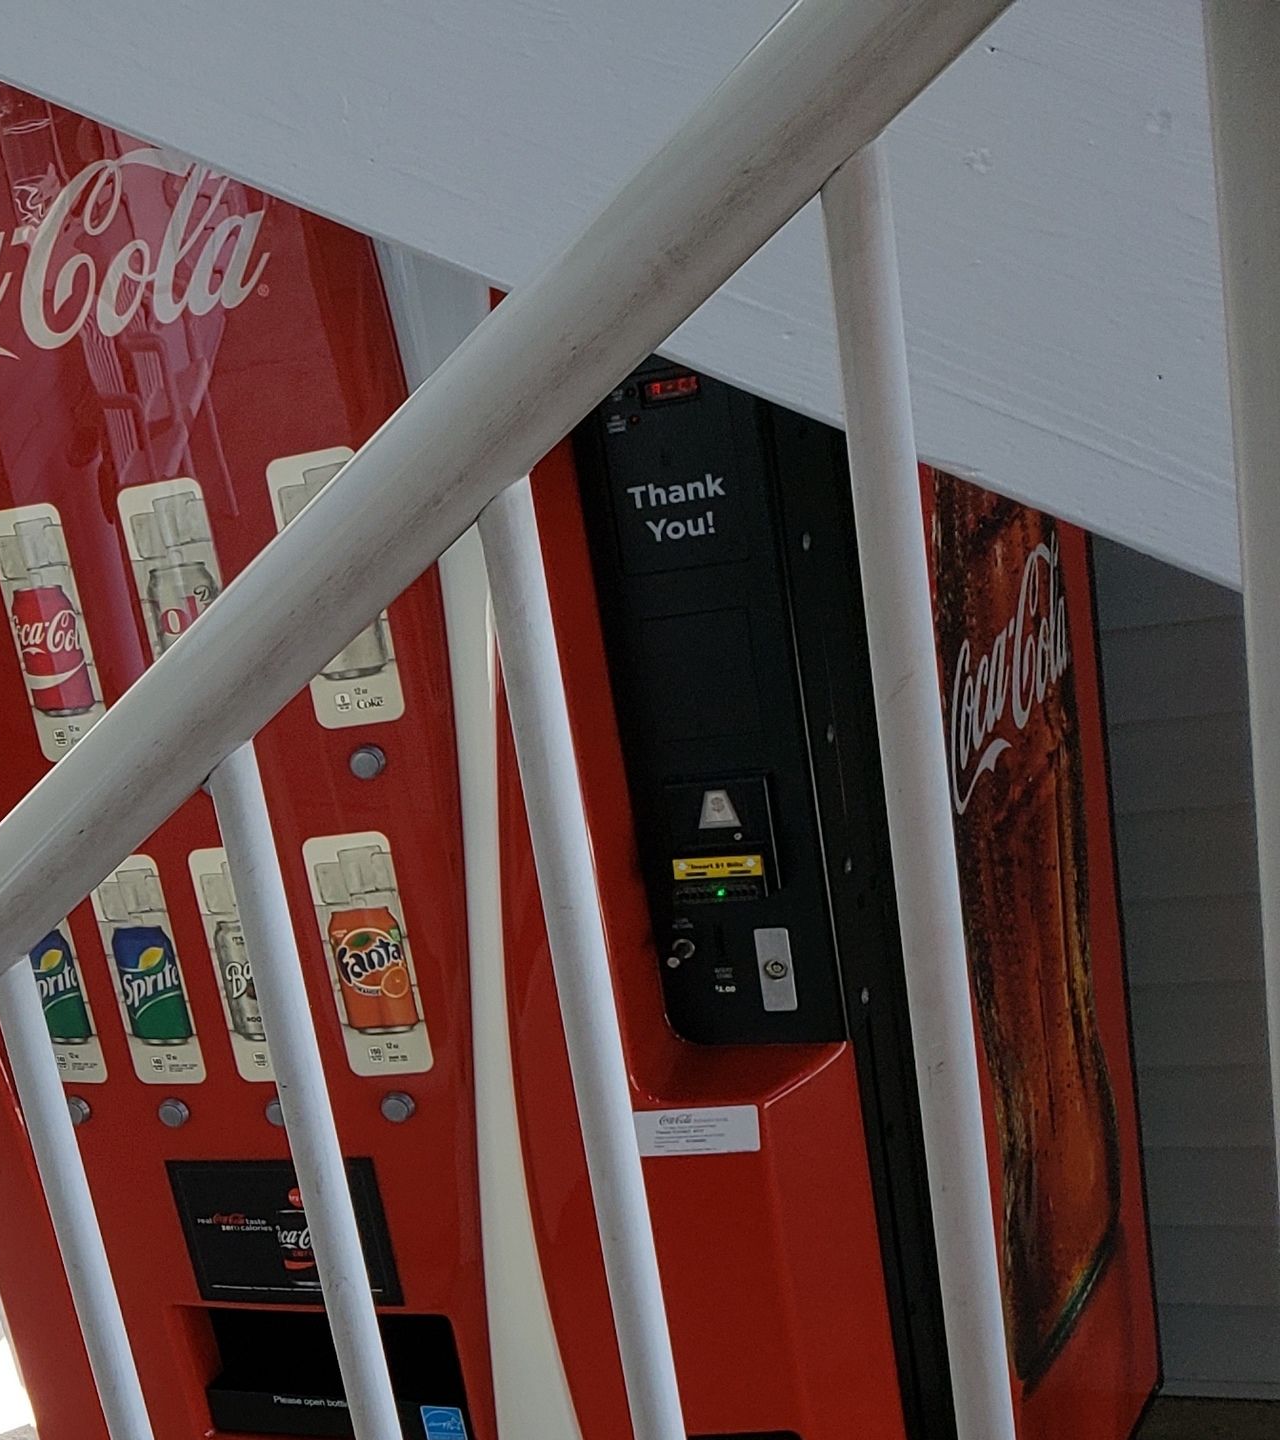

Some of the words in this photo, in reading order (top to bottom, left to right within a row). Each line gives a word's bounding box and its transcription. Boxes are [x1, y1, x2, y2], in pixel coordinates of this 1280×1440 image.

[627, 474, 726, 509] Thank
[645, 511, 715, 542] You!
[951, 531, 1068, 815] Coca-Cola
[37, 960, 77, 999] prite
[338, 937, 402, 986] Fanta
[123, 960, 179, 1008] Sprite
[241, 1224, 273, 1232] calories
[303, 1398, 325, 1408] open
